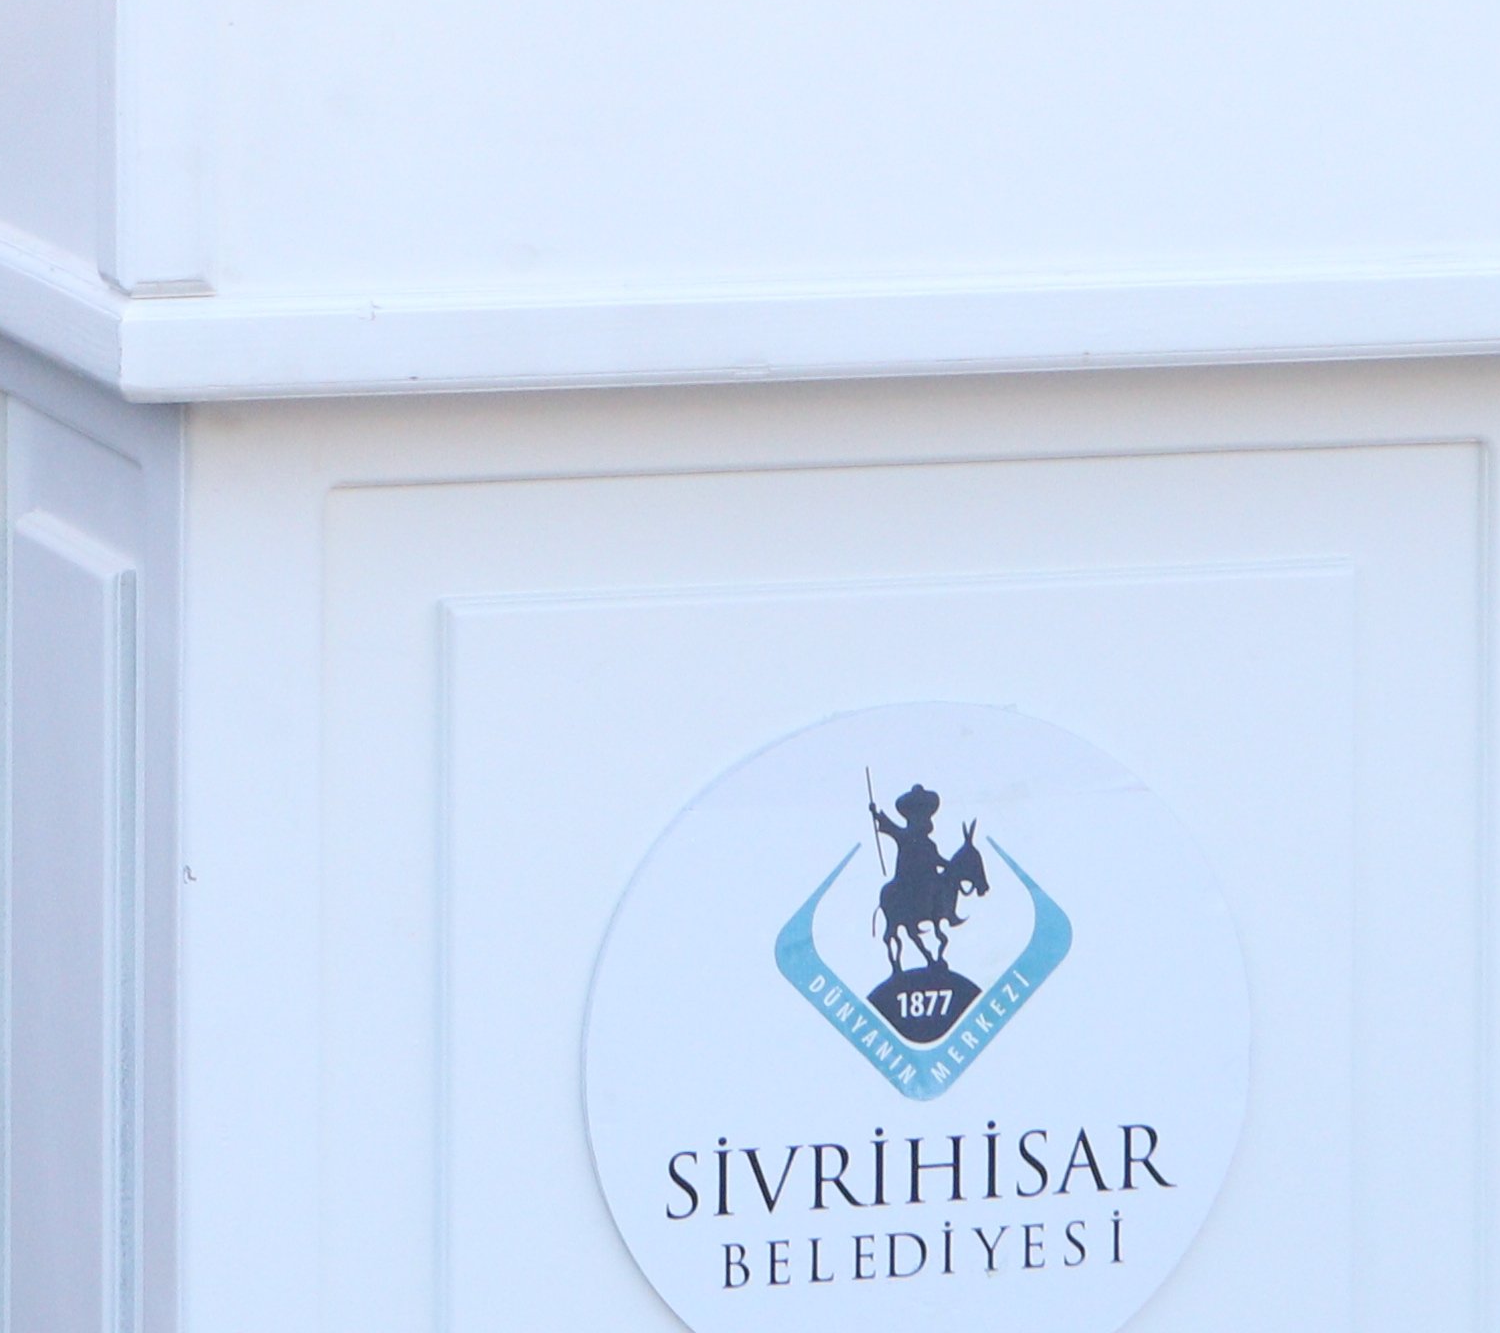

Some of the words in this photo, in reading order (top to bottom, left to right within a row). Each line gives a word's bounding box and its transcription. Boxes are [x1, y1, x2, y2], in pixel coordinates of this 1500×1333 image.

[897, 989, 953, 1018] 1877
[930, 970, 1030, 1085] MERKEZİ
[666, 1120, 1178, 1221] SİVRİHİSAR
[722, 1209, 1125, 1290] BELEDİYESİ
